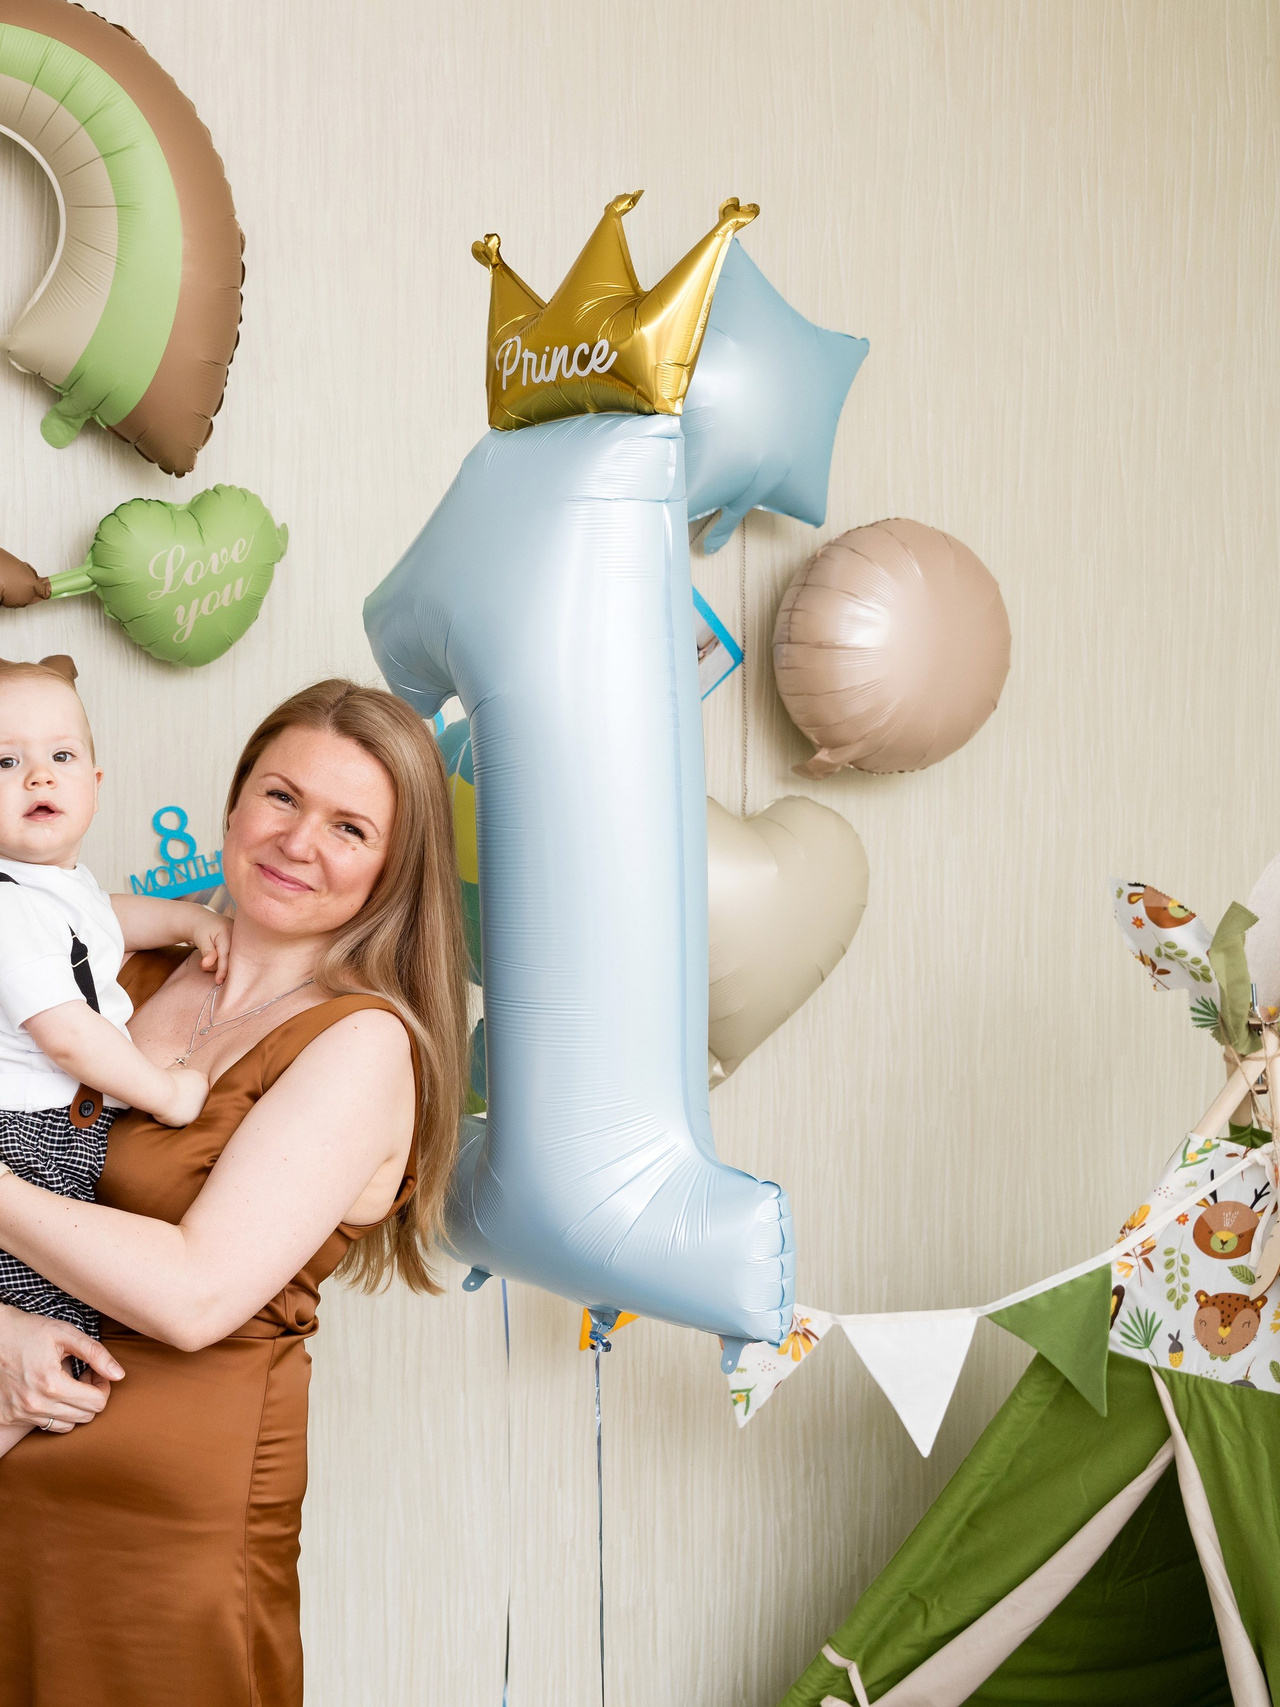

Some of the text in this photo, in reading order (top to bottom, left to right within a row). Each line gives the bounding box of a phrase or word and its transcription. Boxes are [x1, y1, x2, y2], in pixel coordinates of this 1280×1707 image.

[496, 336, 618, 390] Prince
[148, 534, 254, 600] Love
[173, 574, 253, 644] you
[152, 806, 197, 864] 8
